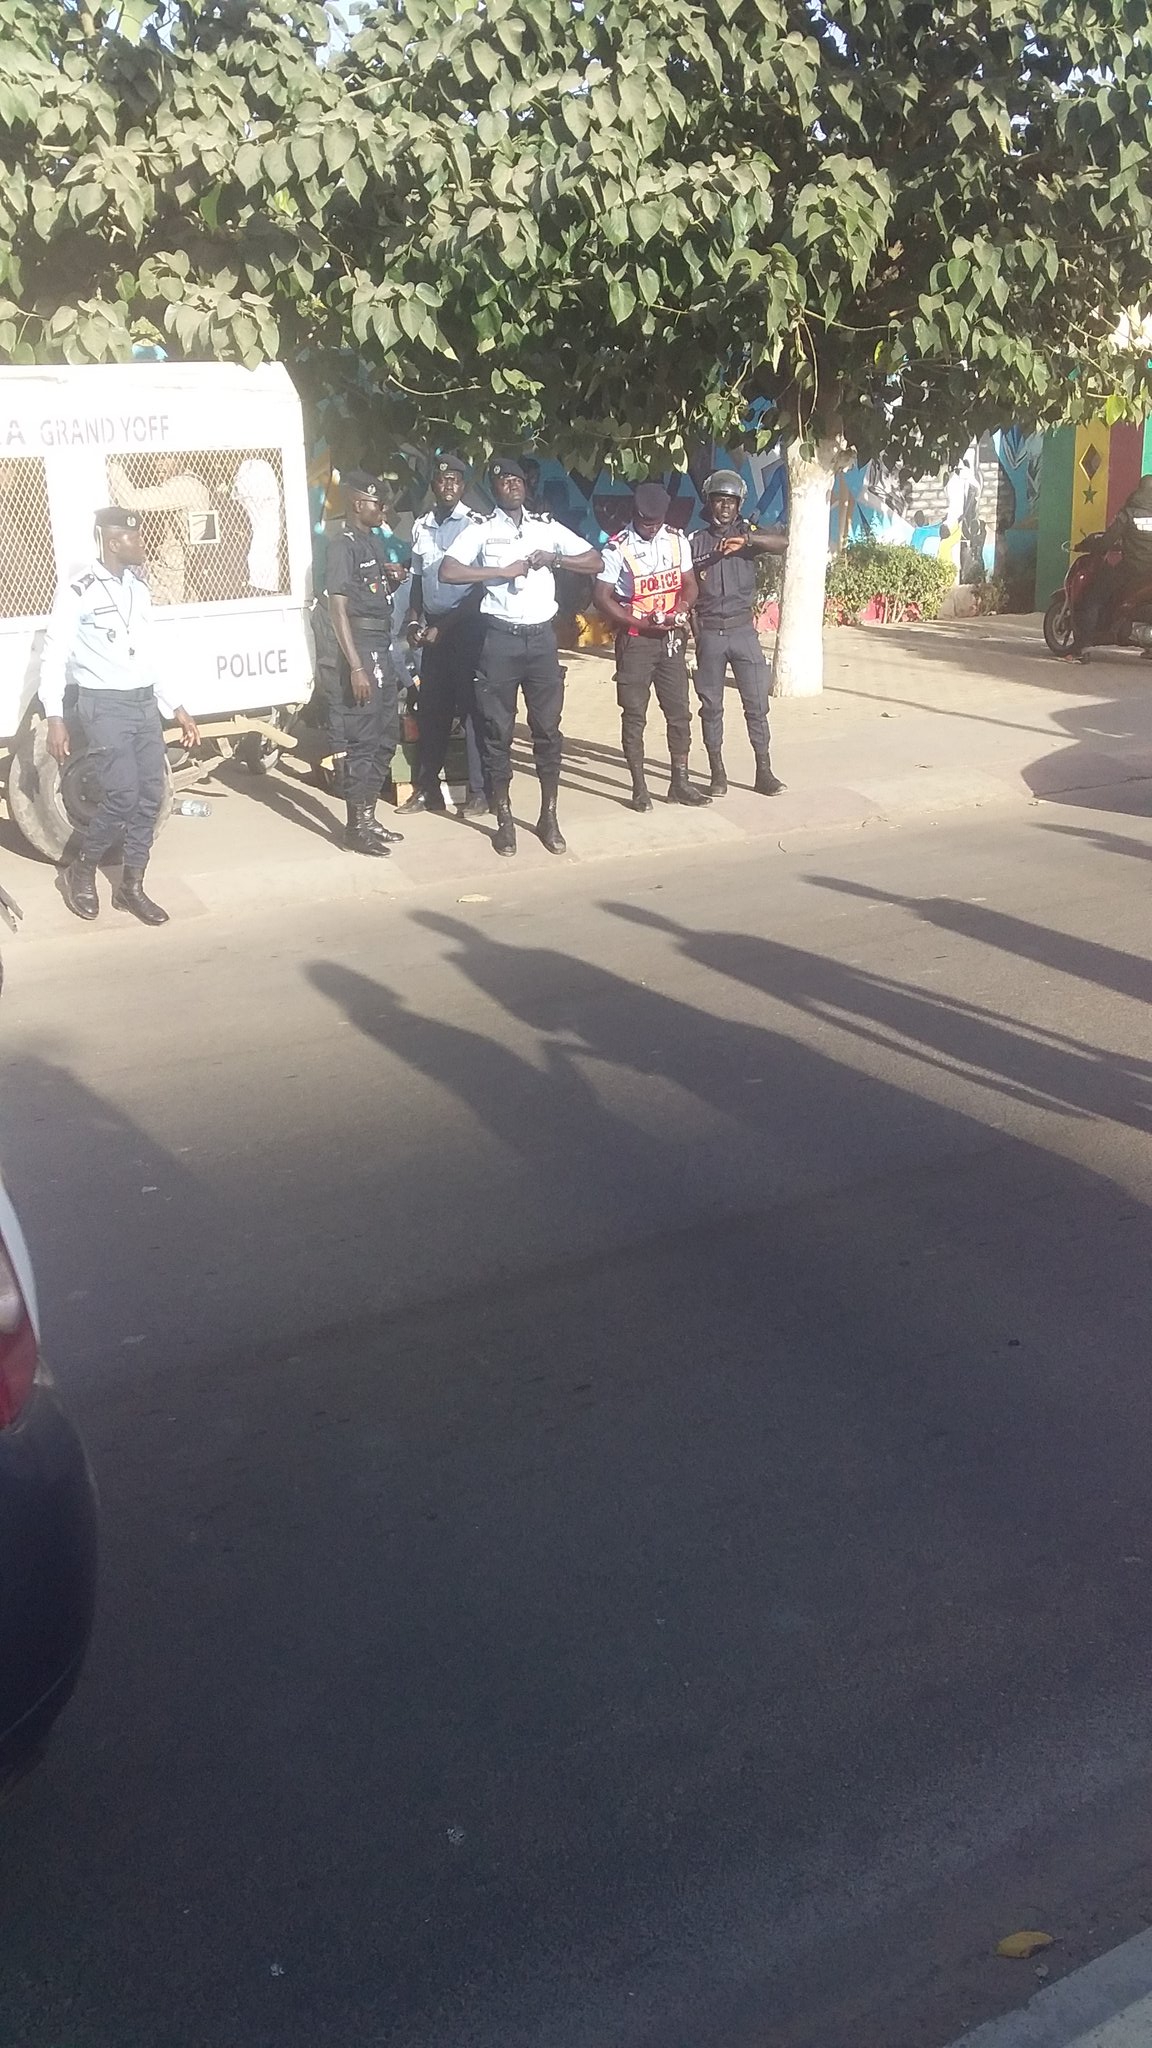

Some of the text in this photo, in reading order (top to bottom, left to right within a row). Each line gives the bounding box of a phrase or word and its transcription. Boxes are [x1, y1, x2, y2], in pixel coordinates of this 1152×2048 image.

[0, 415, 169, 446] A GRAND YOFF
[640, 570, 679, 594] POLICE
[216, 649, 288, 680] POLICE
